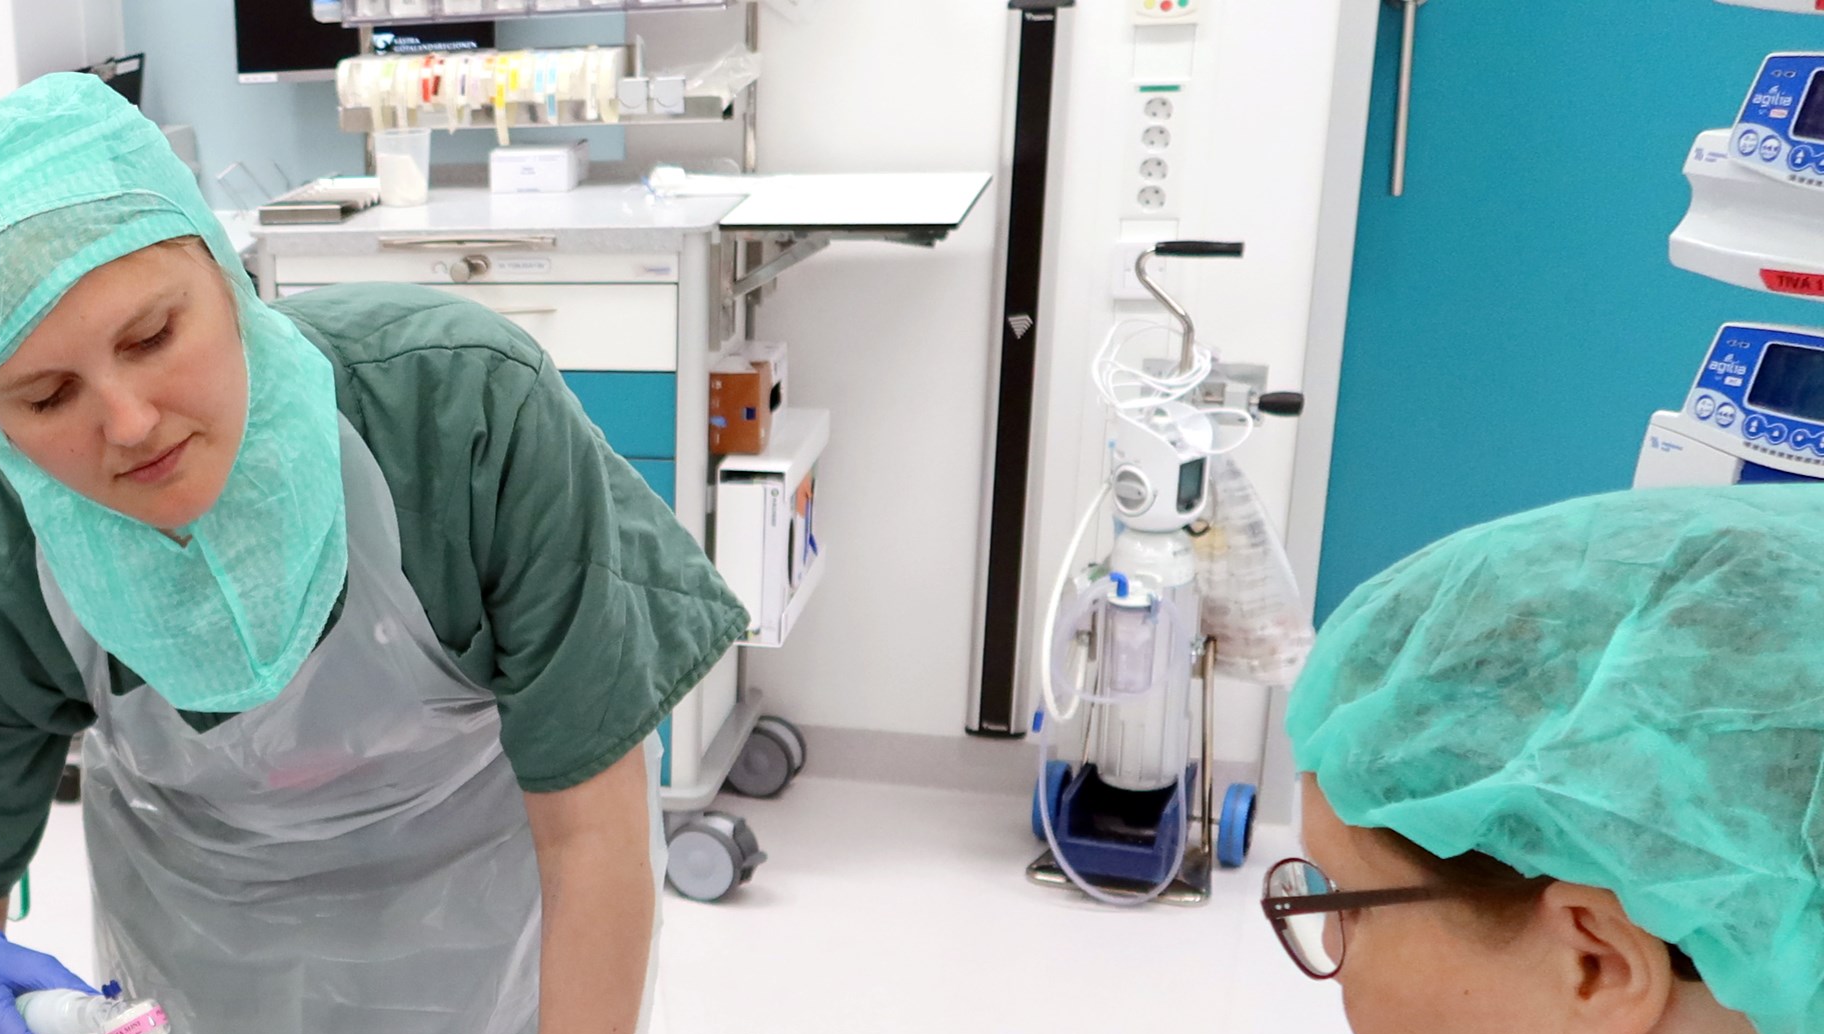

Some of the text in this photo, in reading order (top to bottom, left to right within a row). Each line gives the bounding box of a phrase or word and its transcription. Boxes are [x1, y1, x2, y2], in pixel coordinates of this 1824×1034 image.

[1752, 90, 1793, 108] agilia
[1776, 274, 1811, 290] TIVA
[1708, 360, 1747, 376] agilia
